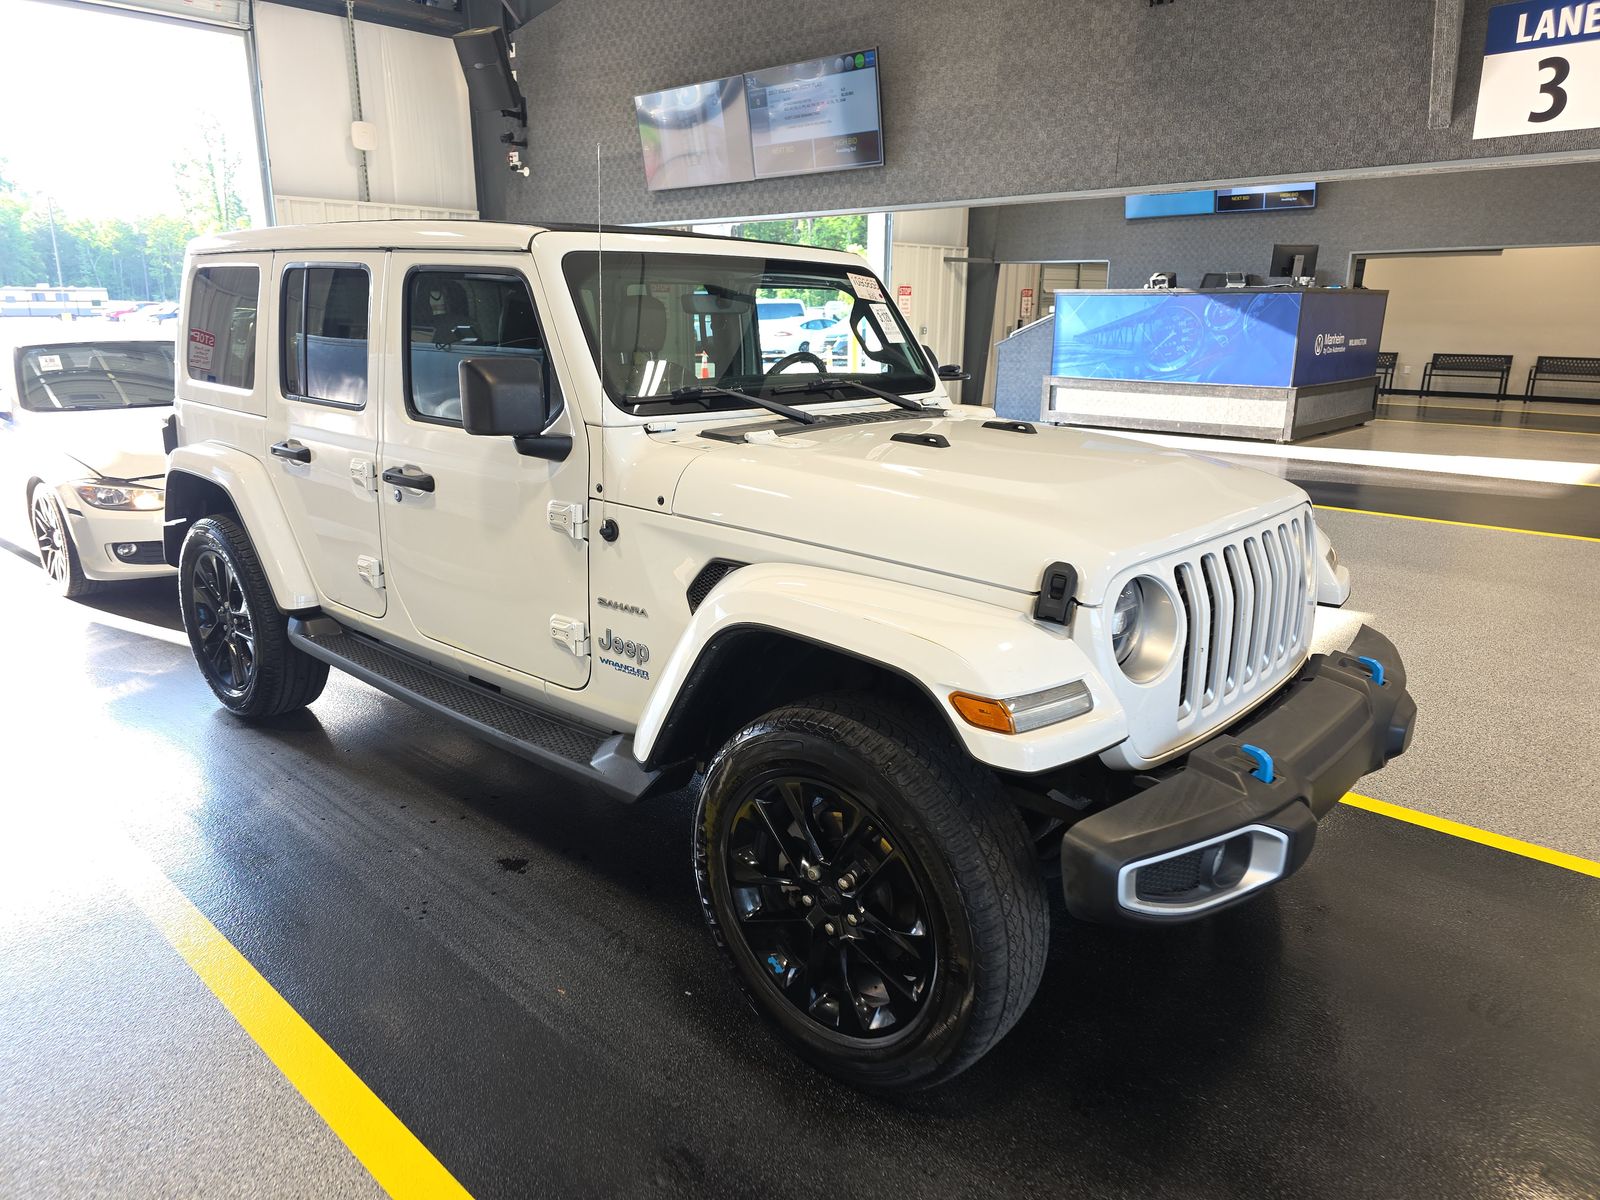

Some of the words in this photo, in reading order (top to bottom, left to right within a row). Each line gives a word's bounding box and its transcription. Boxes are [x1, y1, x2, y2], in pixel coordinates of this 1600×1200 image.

[1516, 2, 1600, 44] LANE
[1528, 56, 1570, 123] 3
[1324, 333, 1345, 345] Manheim
[597, 597, 648, 618] SAHARA
[598, 628, 650, 666] Jeep
[599, 656, 649, 677] WRANGLER
